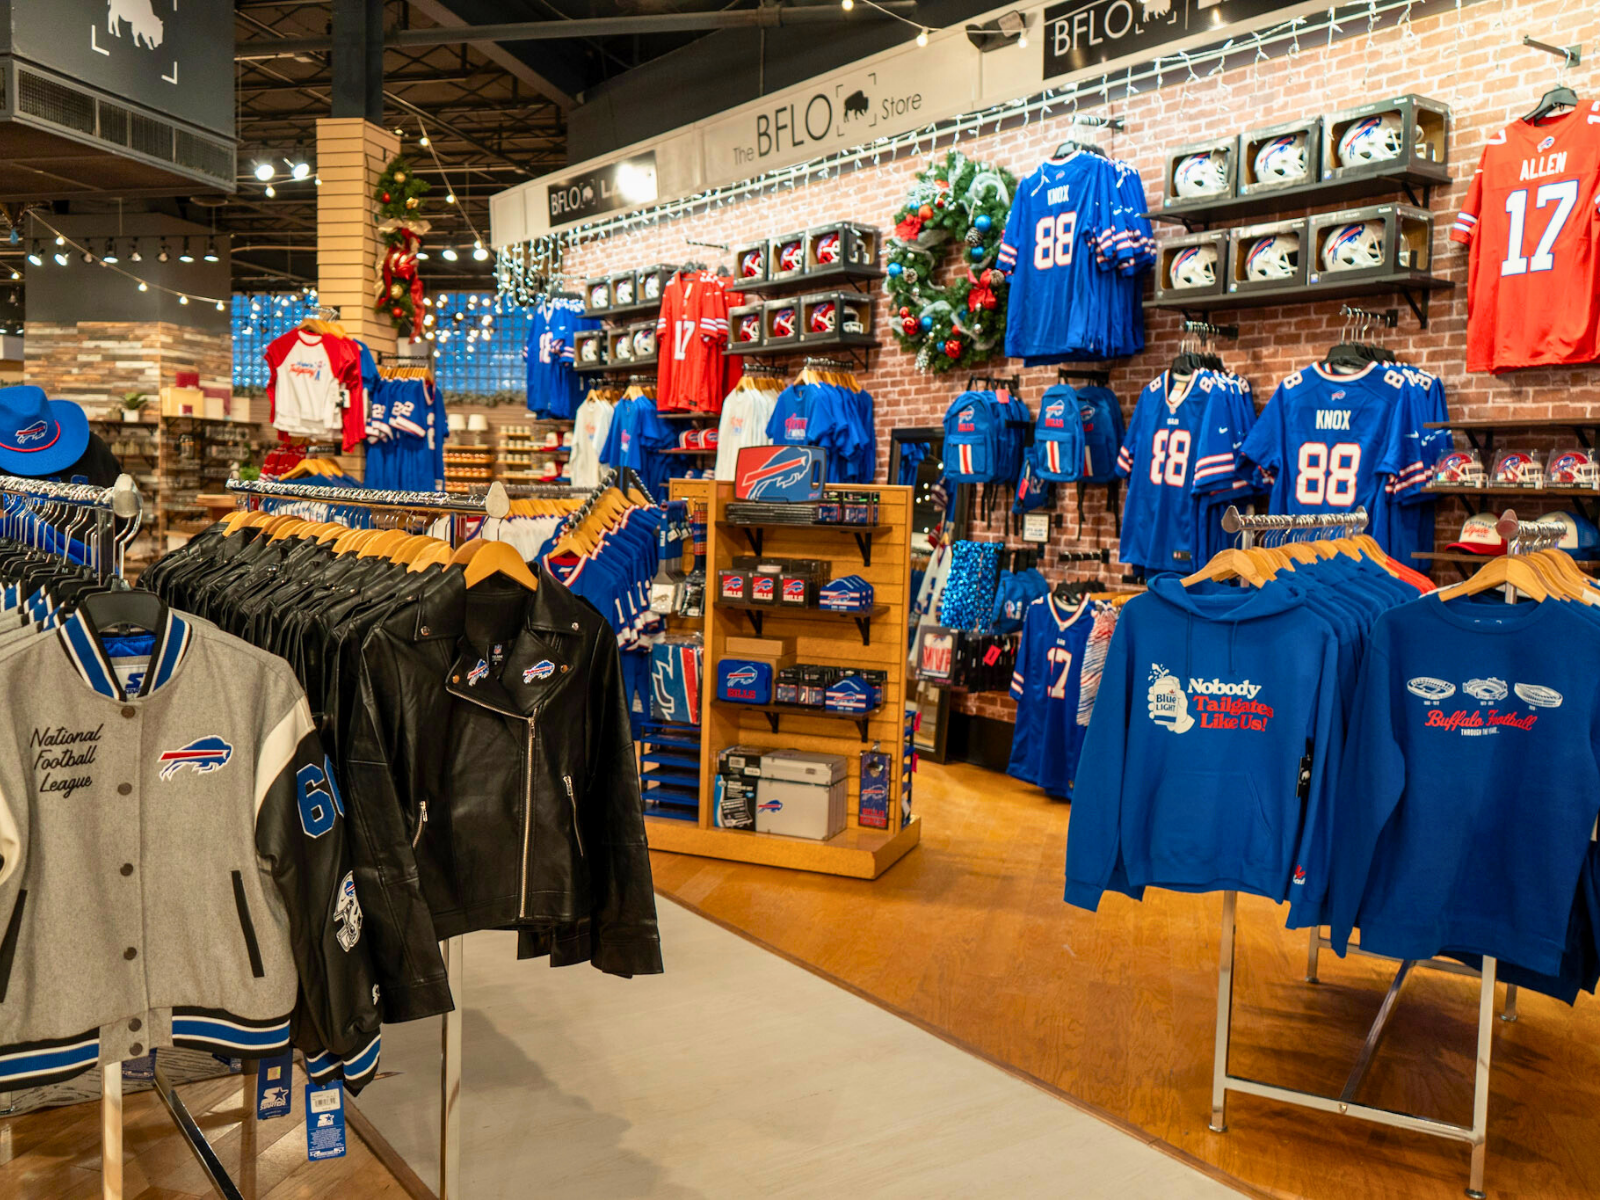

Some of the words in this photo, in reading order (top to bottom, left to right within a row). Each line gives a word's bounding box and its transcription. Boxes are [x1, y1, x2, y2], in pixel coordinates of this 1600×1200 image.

[1054, 0, 1133, 56] BFLO
[733, 146, 754, 165] The
[756, 93, 832, 158] BFLO
[881, 93, 922, 120] Store
[1519, 151, 1568, 181] ALLEN
[550, 186, 581, 216] BFLO
[1047, 184, 1070, 206] KNOX
[1033, 211, 1077, 270] 88
[1501, 179, 1580, 277] 17
[674, 320, 696, 361] 17
[1315, 409, 1351, 430] KNOX
[1149, 429, 1192, 488] 88
[1295, 441, 1361, 507] 88
[727, 688, 756, 700] BILLS
[1156, 693, 1177, 704] Blue
[1187, 678, 1262, 699] Nobody
[1155, 702, 1176, 712] LIGHT
[1192, 695, 1274, 718] Tailgates
[1199, 713, 1239, 729] Like
[1239, 714, 1268, 732] Us!
[1424, 709, 1485, 732] Buffalo
[1485, 709, 1538, 731] Football
[30, 723, 104, 749] National
[34, 745, 98, 771] Football
[39, 772, 92, 799] League
